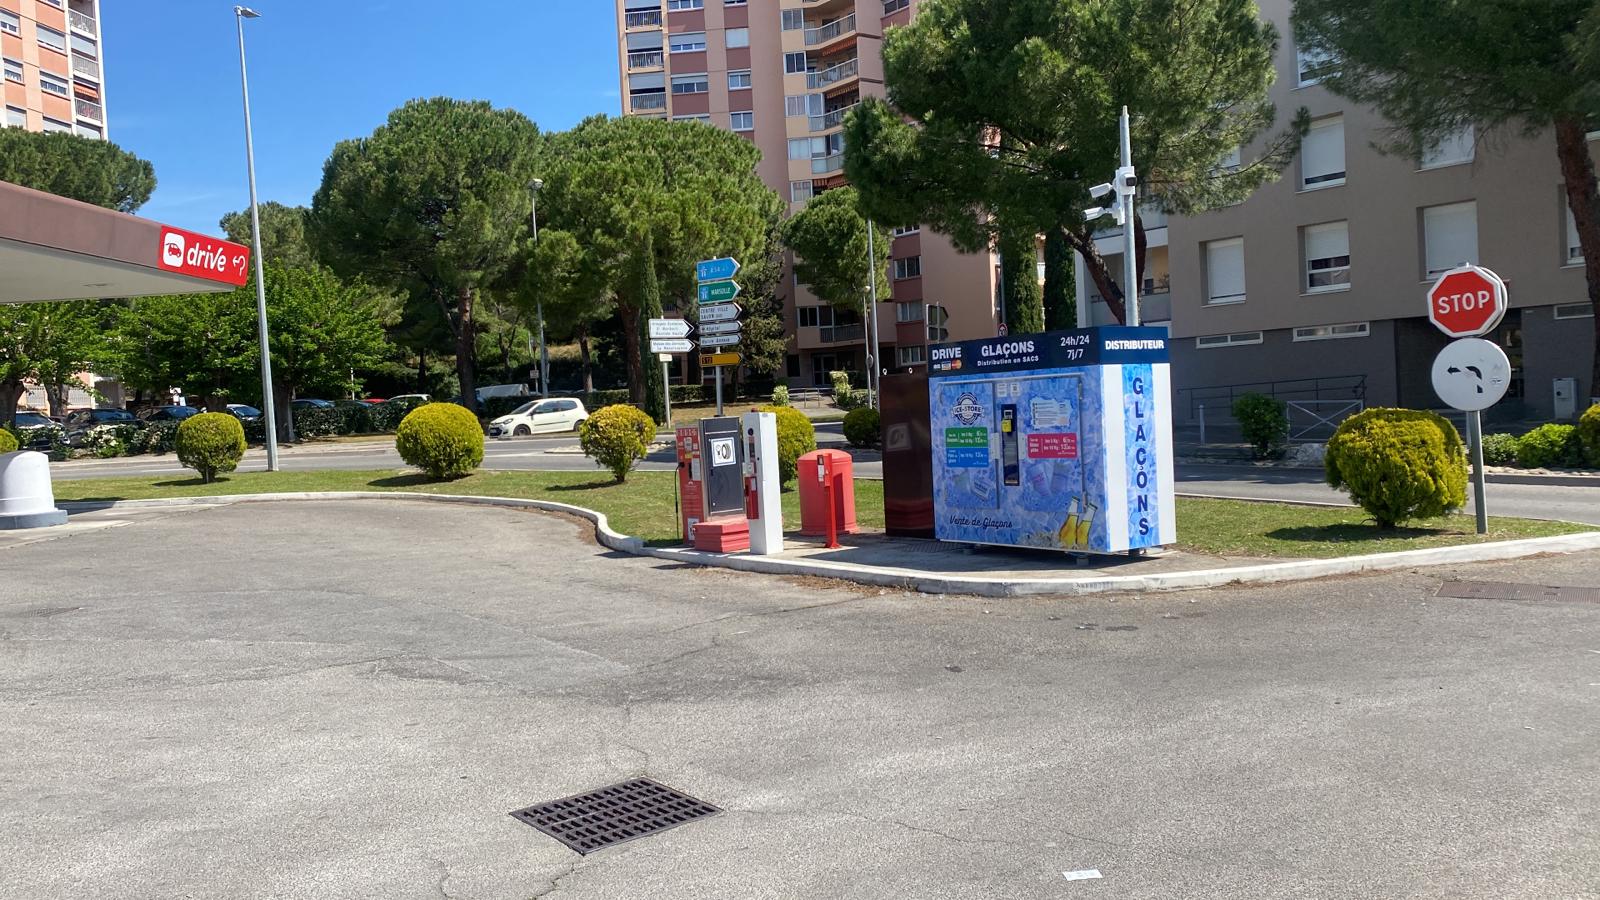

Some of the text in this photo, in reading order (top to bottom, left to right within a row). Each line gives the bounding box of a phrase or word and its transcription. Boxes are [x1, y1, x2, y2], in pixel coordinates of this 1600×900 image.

[187, 242, 227, 272] drive
[1438, 290, 1490, 314] STOP
[1060, 335, 1090, 347] 24h/24
[1105, 340, 1165, 350] DISTRIBUTEUR
[932, 347, 962, 360] DRIVE
[981, 340, 1036, 358] GLAÇONS
[1067, 349, 1084, 360] 7j/7
[977, 358, 1012, 367] Distribution
[1022, 355, 1039, 363] SACS
[949, 514, 1013, 530] Vente de Glaçons
